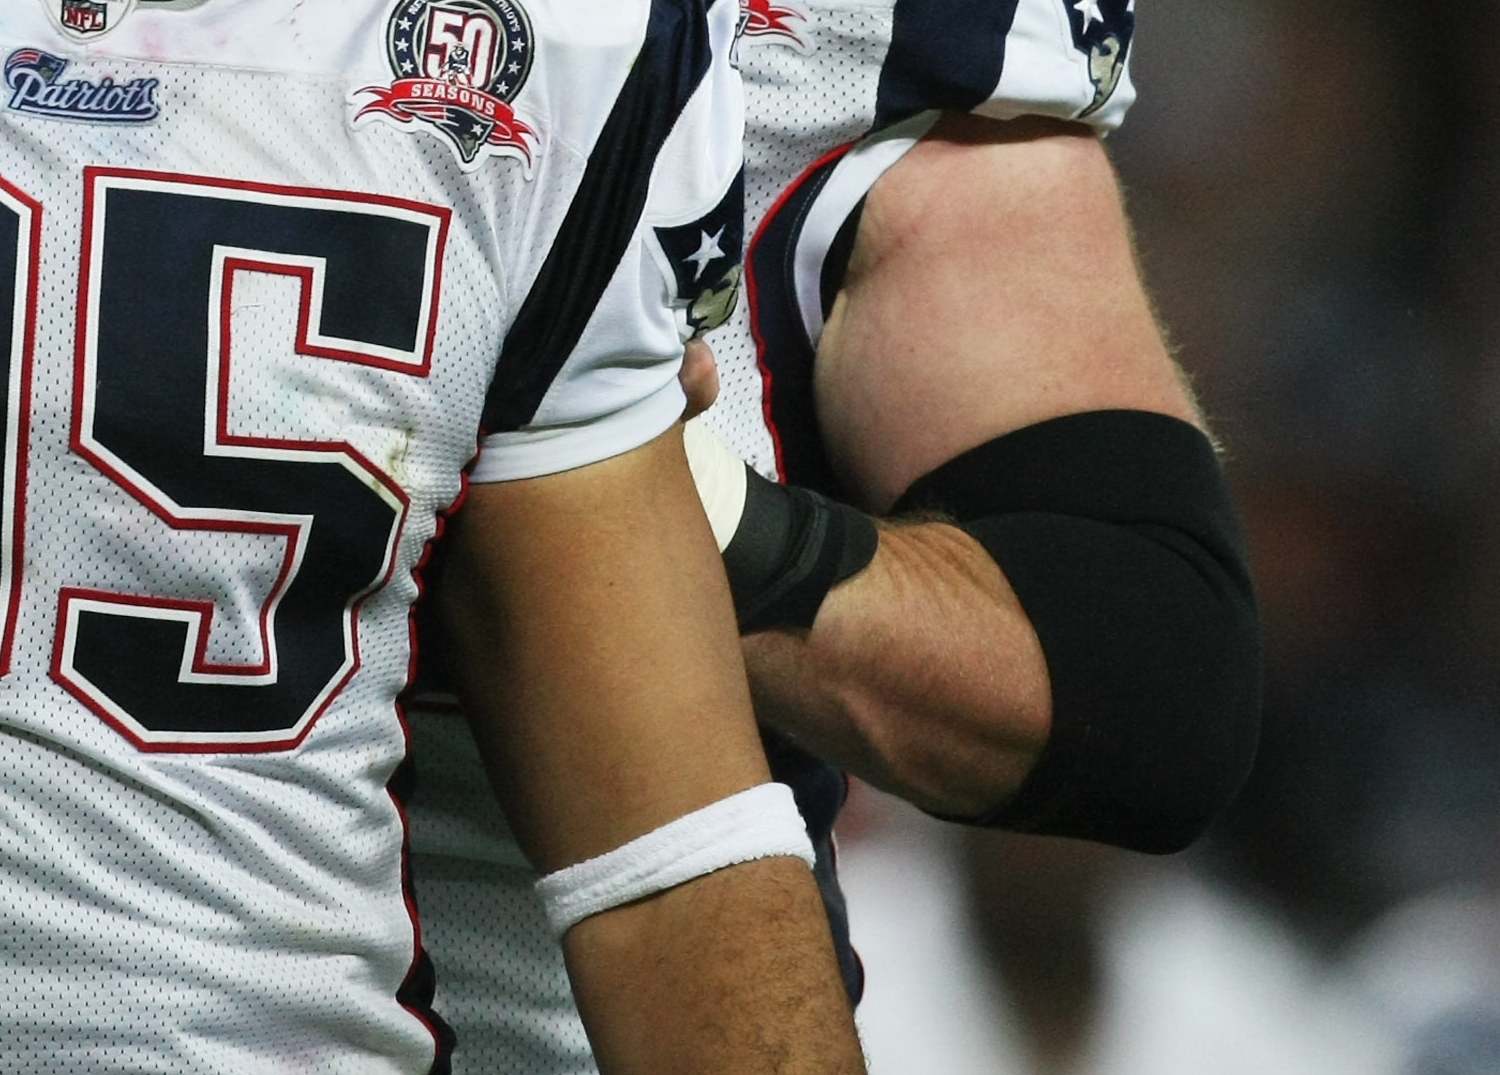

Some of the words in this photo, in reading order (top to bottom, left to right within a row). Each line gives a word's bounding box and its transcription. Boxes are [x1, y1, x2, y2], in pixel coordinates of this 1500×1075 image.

[64, 5, 103, 28] NFL
[422, 7, 500, 90] 50
[5, 66, 160, 121] Patriots
[410, 83, 497, 116] SEASONS
